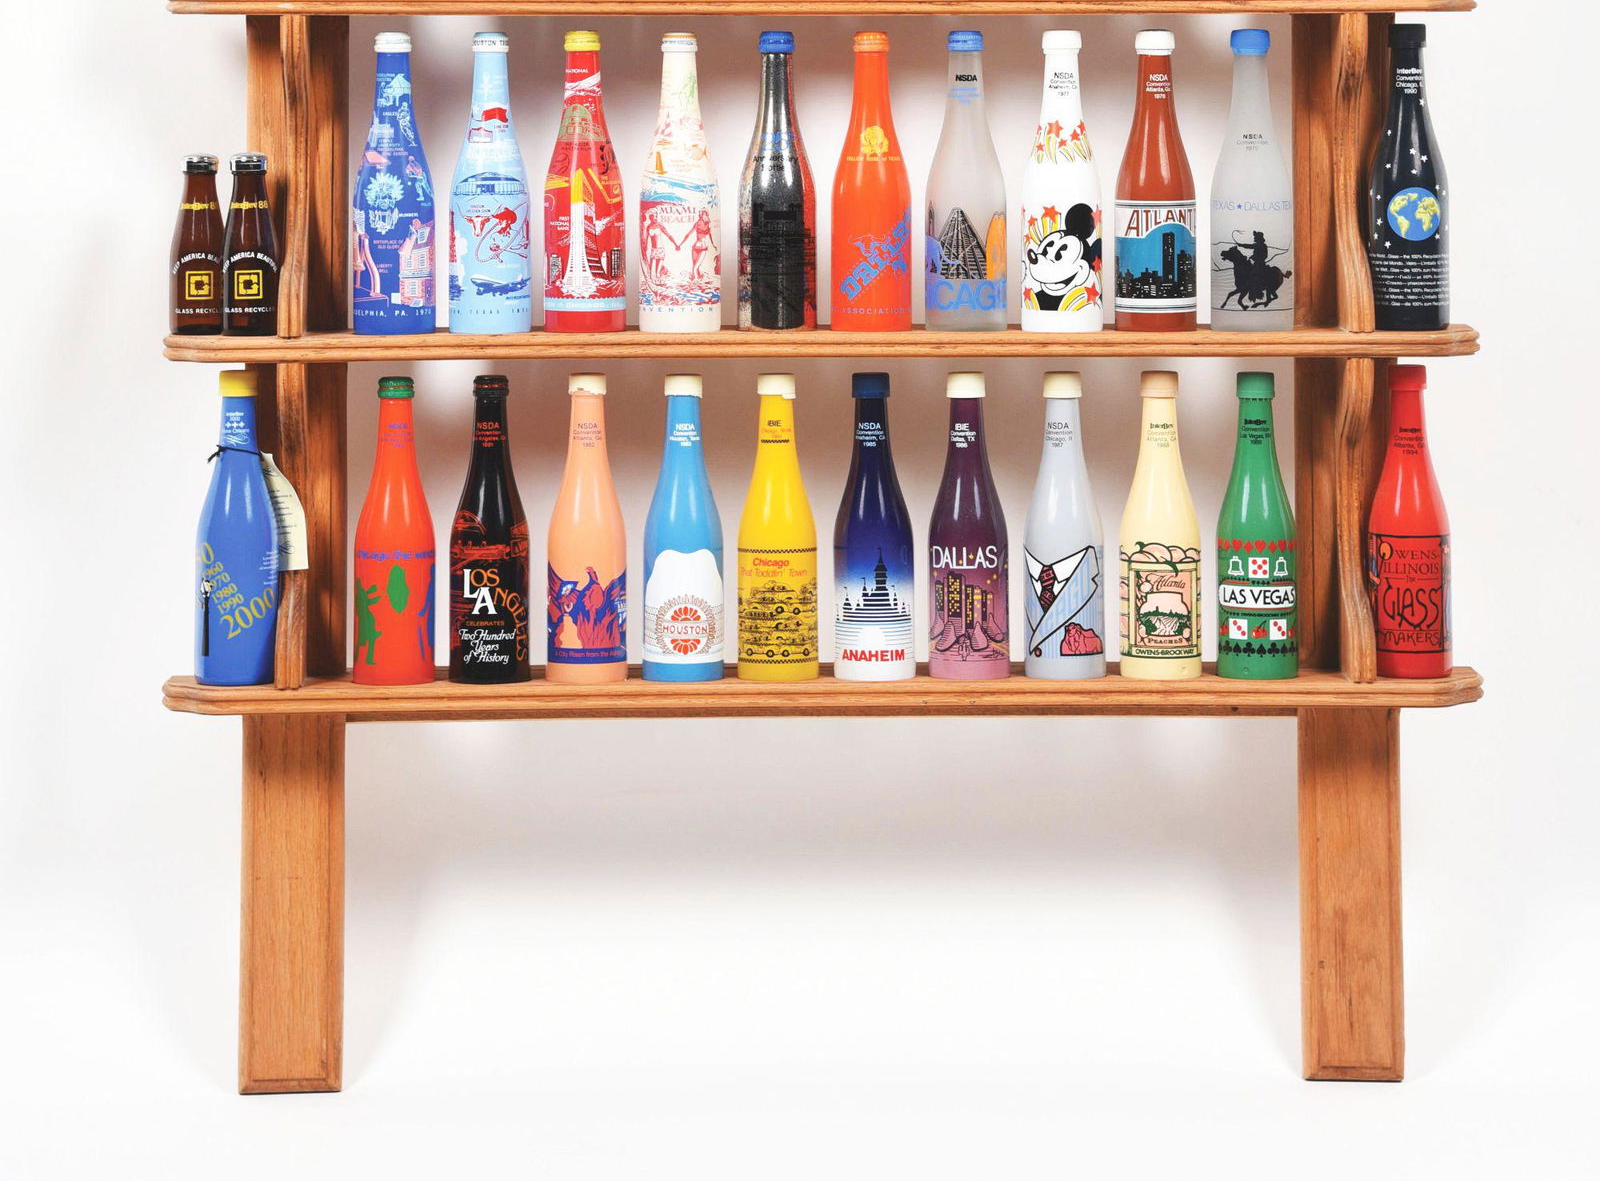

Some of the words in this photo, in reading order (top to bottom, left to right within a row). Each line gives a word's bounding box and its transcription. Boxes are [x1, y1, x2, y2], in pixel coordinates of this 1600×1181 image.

[955, 74, 978, 82] NSDA
[258, 200, 269, 209] 88
[660, 205, 697, 215] MIAMI
[1244, 200, 1280, 211] DALLAS
[1124, 209, 1196, 237] ATLANT
[181, 253, 206, 263] AMERICA
[230, 251, 255, 262] AMERICA
[175, 307, 194, 315] GLASS
[858, 422, 882, 430] NSDA
[752, 557, 790, 568] Chicago
[932, 545, 998, 569] DALLAS
[789, 568, 808, 577] Town
[1380, 561, 1440, 575] ILLINOIS
[463, 568, 500, 599] LOS
[1149, 571, 1187, 591] Atlanta
[211, 583, 238, 605] 1980
[1222, 588, 1247, 605] LAS
[1249, 588, 1295, 606] VEGAS
[216, 593, 245, 614] 1990
[1382, 577, 1442, 631] GLASS
[220, 586, 276, 641] 2000
[471, 586, 529, 662] ANGELES
[662, 624, 708, 635] HOUSTON
[458, 628, 477, 641] Two
[474, 628, 516, 642] Hundred
[1146, 635, 1184, 645] PEACHES
[1380, 630, 1441, 648] MAKERS
[471, 640, 500, 653] Years
[1135, 647, 1195, 656] OWENS-BROCKWAY
[463, 652, 471, 665] of
[469, 649, 510, 666] History
[558, 650, 569, 659] City
[841, 648, 906, 662] ANAHEIM
